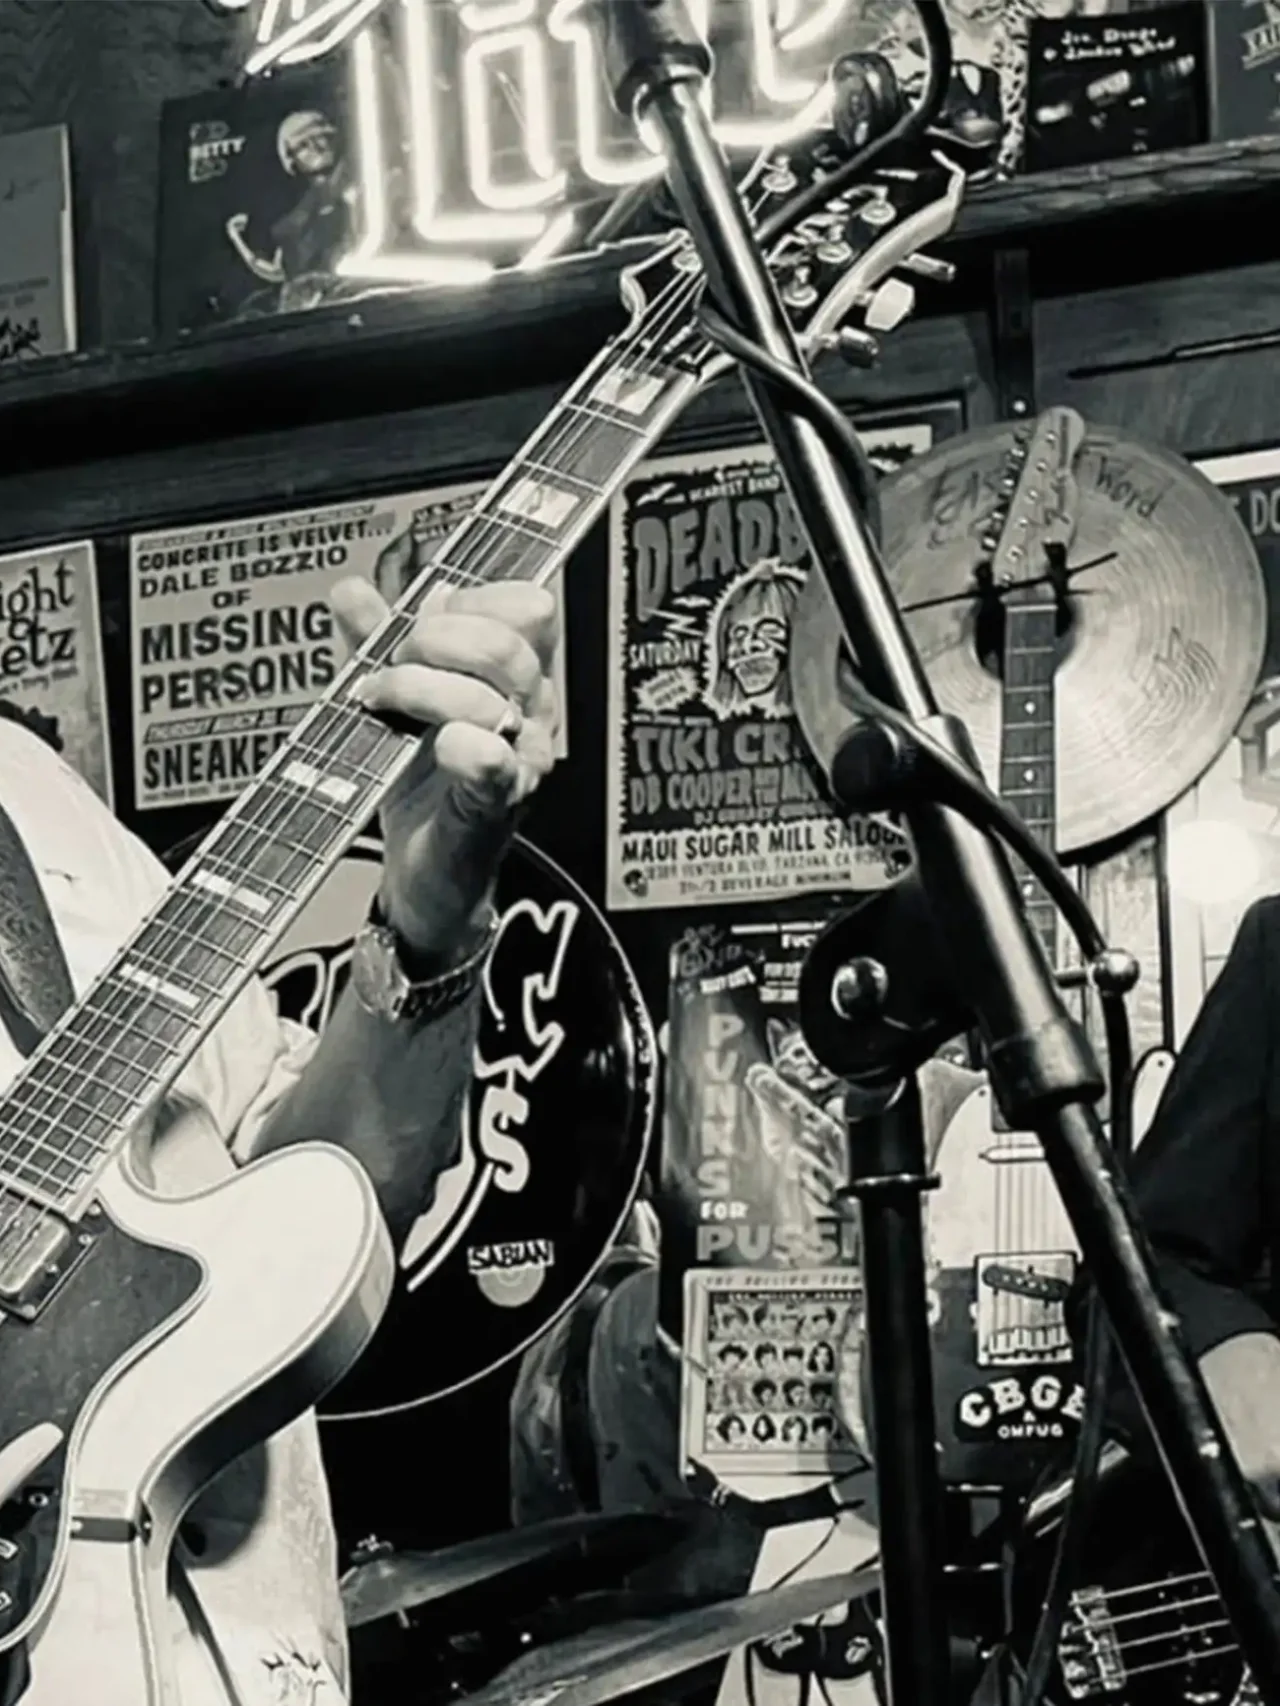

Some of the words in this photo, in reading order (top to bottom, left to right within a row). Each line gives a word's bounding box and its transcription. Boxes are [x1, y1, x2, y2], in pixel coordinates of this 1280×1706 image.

[137, 539, 249, 573] CONCRETE
[257, 532, 281, 554] IS
[139, 566, 218, 600] DALE
[230, 545, 348, 583] BOZZIO
[211, 588, 252, 610] OF
[140, 602, 334, 666] MISSING
[140, 646, 335, 715] PERSONS
[632, 727, 719, 774] TIKI
[630, 774, 662, 815] DB
[667, 767, 752, 810] COOPER
[622, 837, 678, 863] MAUI
[685, 831, 760, 861] SUGAR
[768, 825, 816, 853] MILL
[470, 1240, 553, 1270] SABIAN
